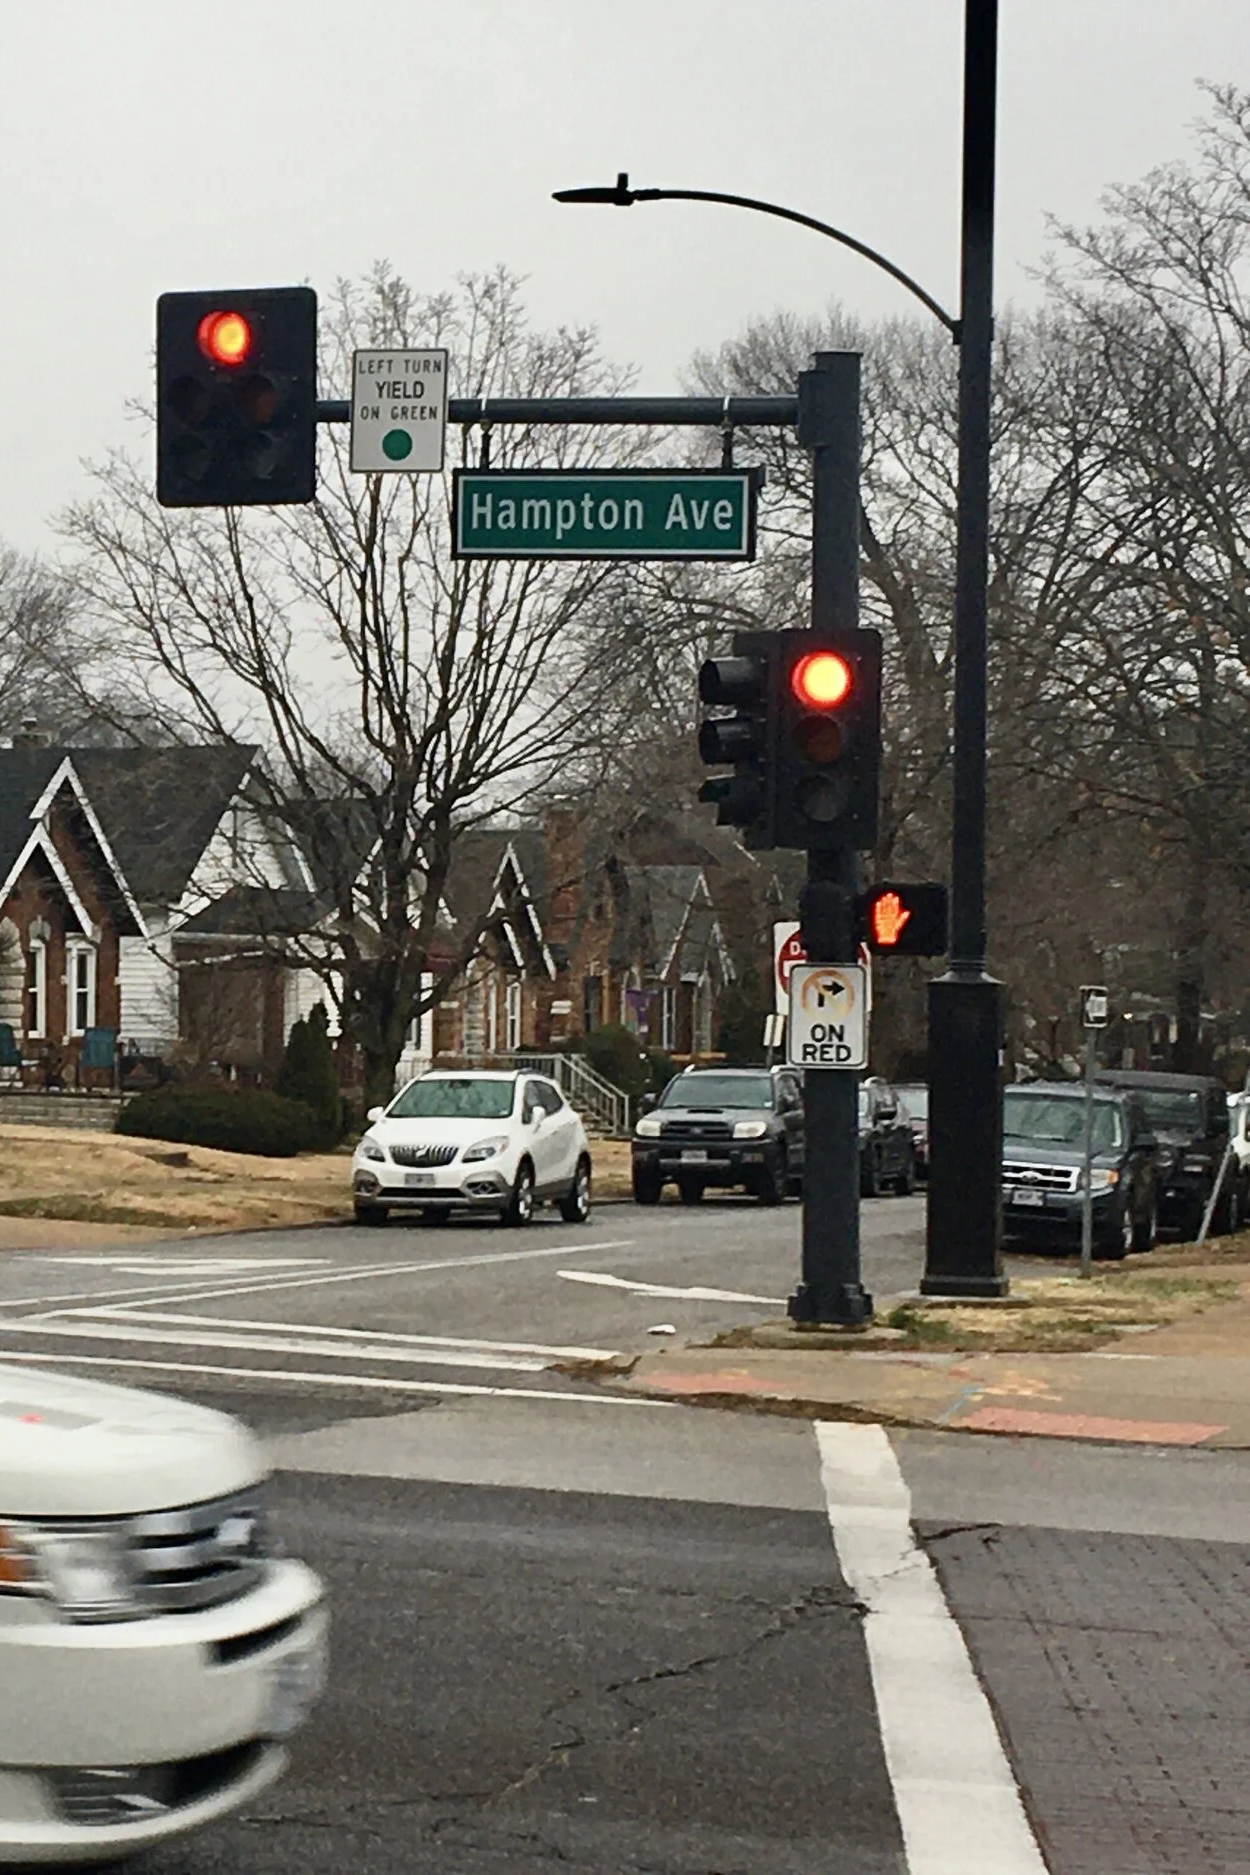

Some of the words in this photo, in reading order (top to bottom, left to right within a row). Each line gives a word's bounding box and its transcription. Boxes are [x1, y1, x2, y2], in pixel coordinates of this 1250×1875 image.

[359, 359, 393, 374] LEFT
[404, 359, 442, 374] TURN
[375, 381, 425, 399] YIELD
[360, 405, 380, 420] ON
[391, 405, 438, 420] GREEN
[471, 493, 643, 540] Hampton
[664, 493, 734, 531] Ave
[810, 1023, 845, 1042] ON
[802, 1043, 852, 1062] RED
